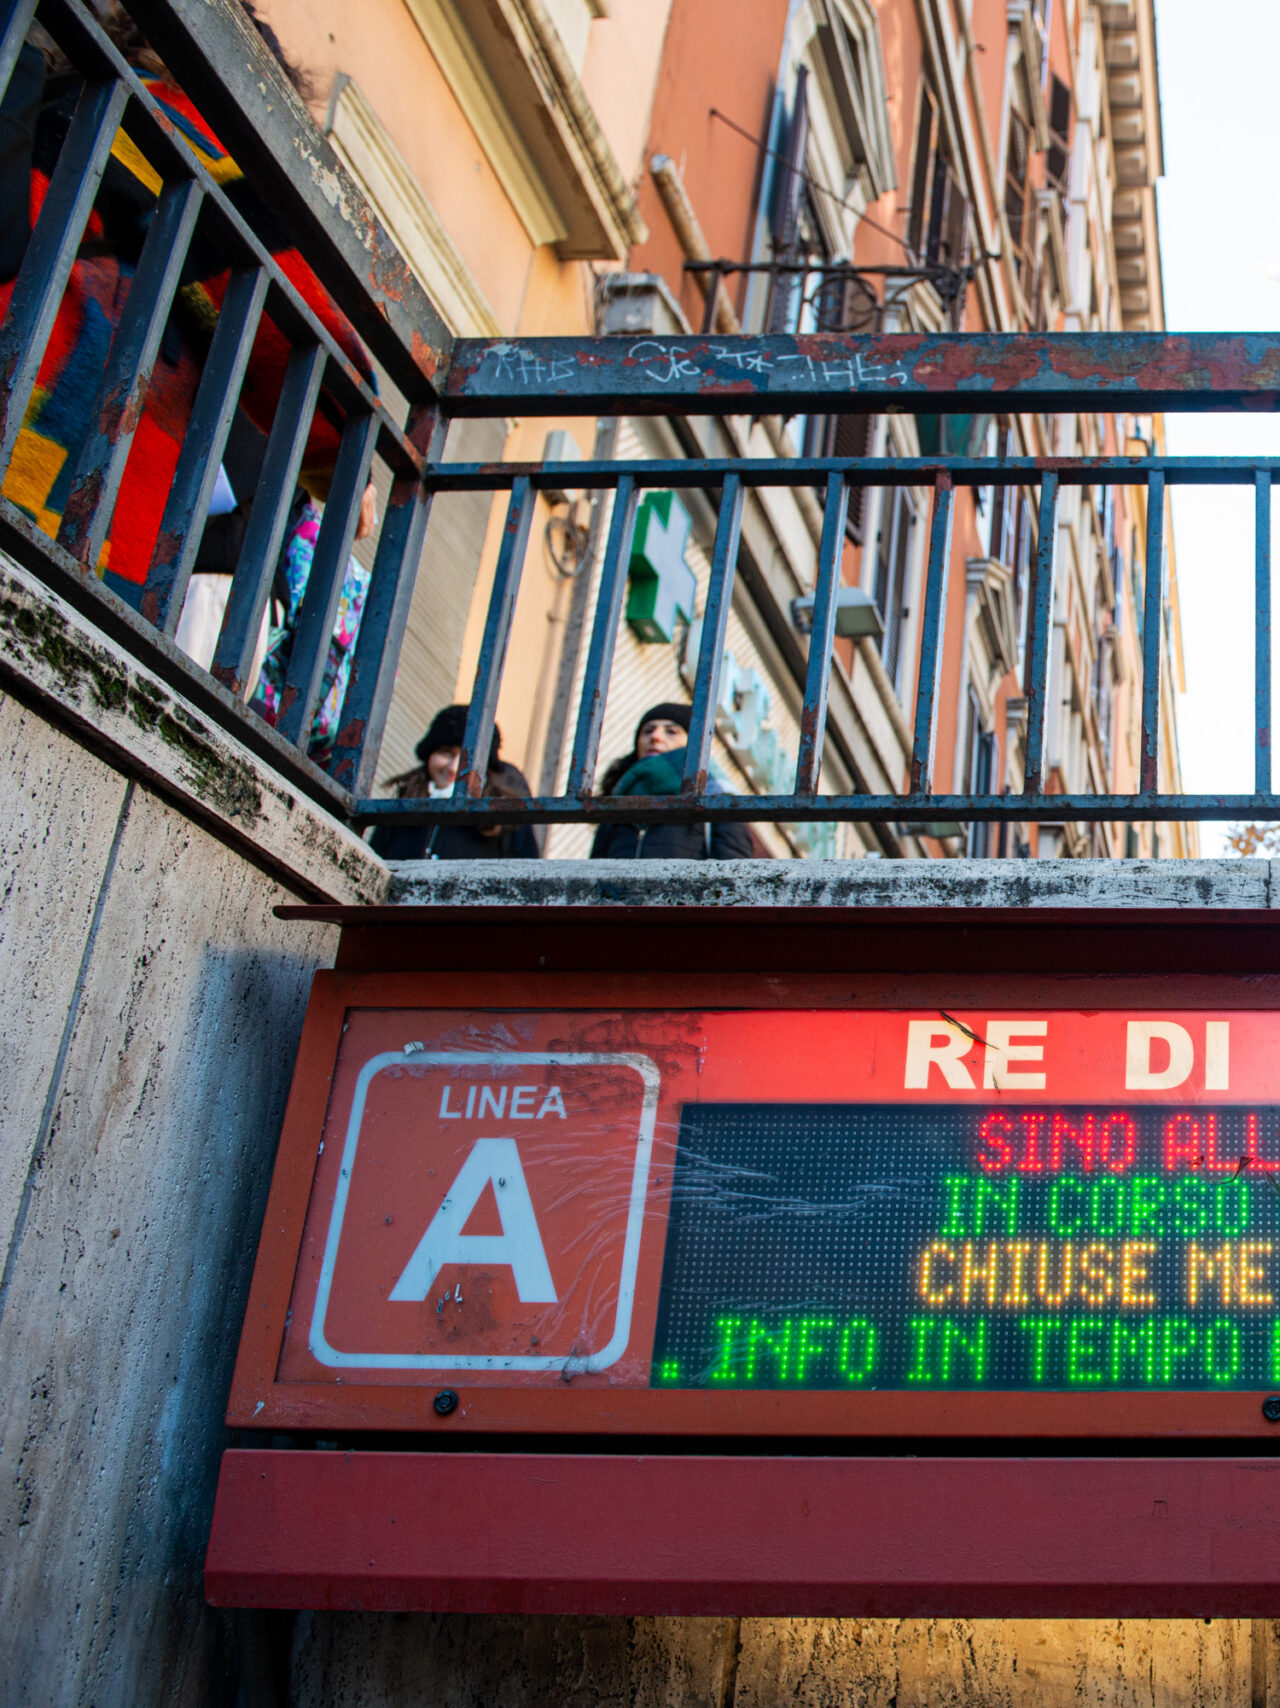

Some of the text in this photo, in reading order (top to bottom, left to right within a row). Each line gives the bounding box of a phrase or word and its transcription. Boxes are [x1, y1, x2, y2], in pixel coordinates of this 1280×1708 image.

[904, 1020, 1048, 1090] RE
[1125, 1020, 1230, 1091] DI
[438, 1085, 568, 1119] LINEA
[976, 1112, 1137, 1172] SINO
[387, 1137, 558, 1303] A
[940, 1175, 1020, 1236] IN
[1049, 1175, 1249, 1237] CORSO
[919, 1241, 1156, 1305] CHIUSE
[711, 1317, 877, 1381] INFO
[907, 1318, 987, 1382] IN
[1019, 1318, 1241, 1382] TEMPO
